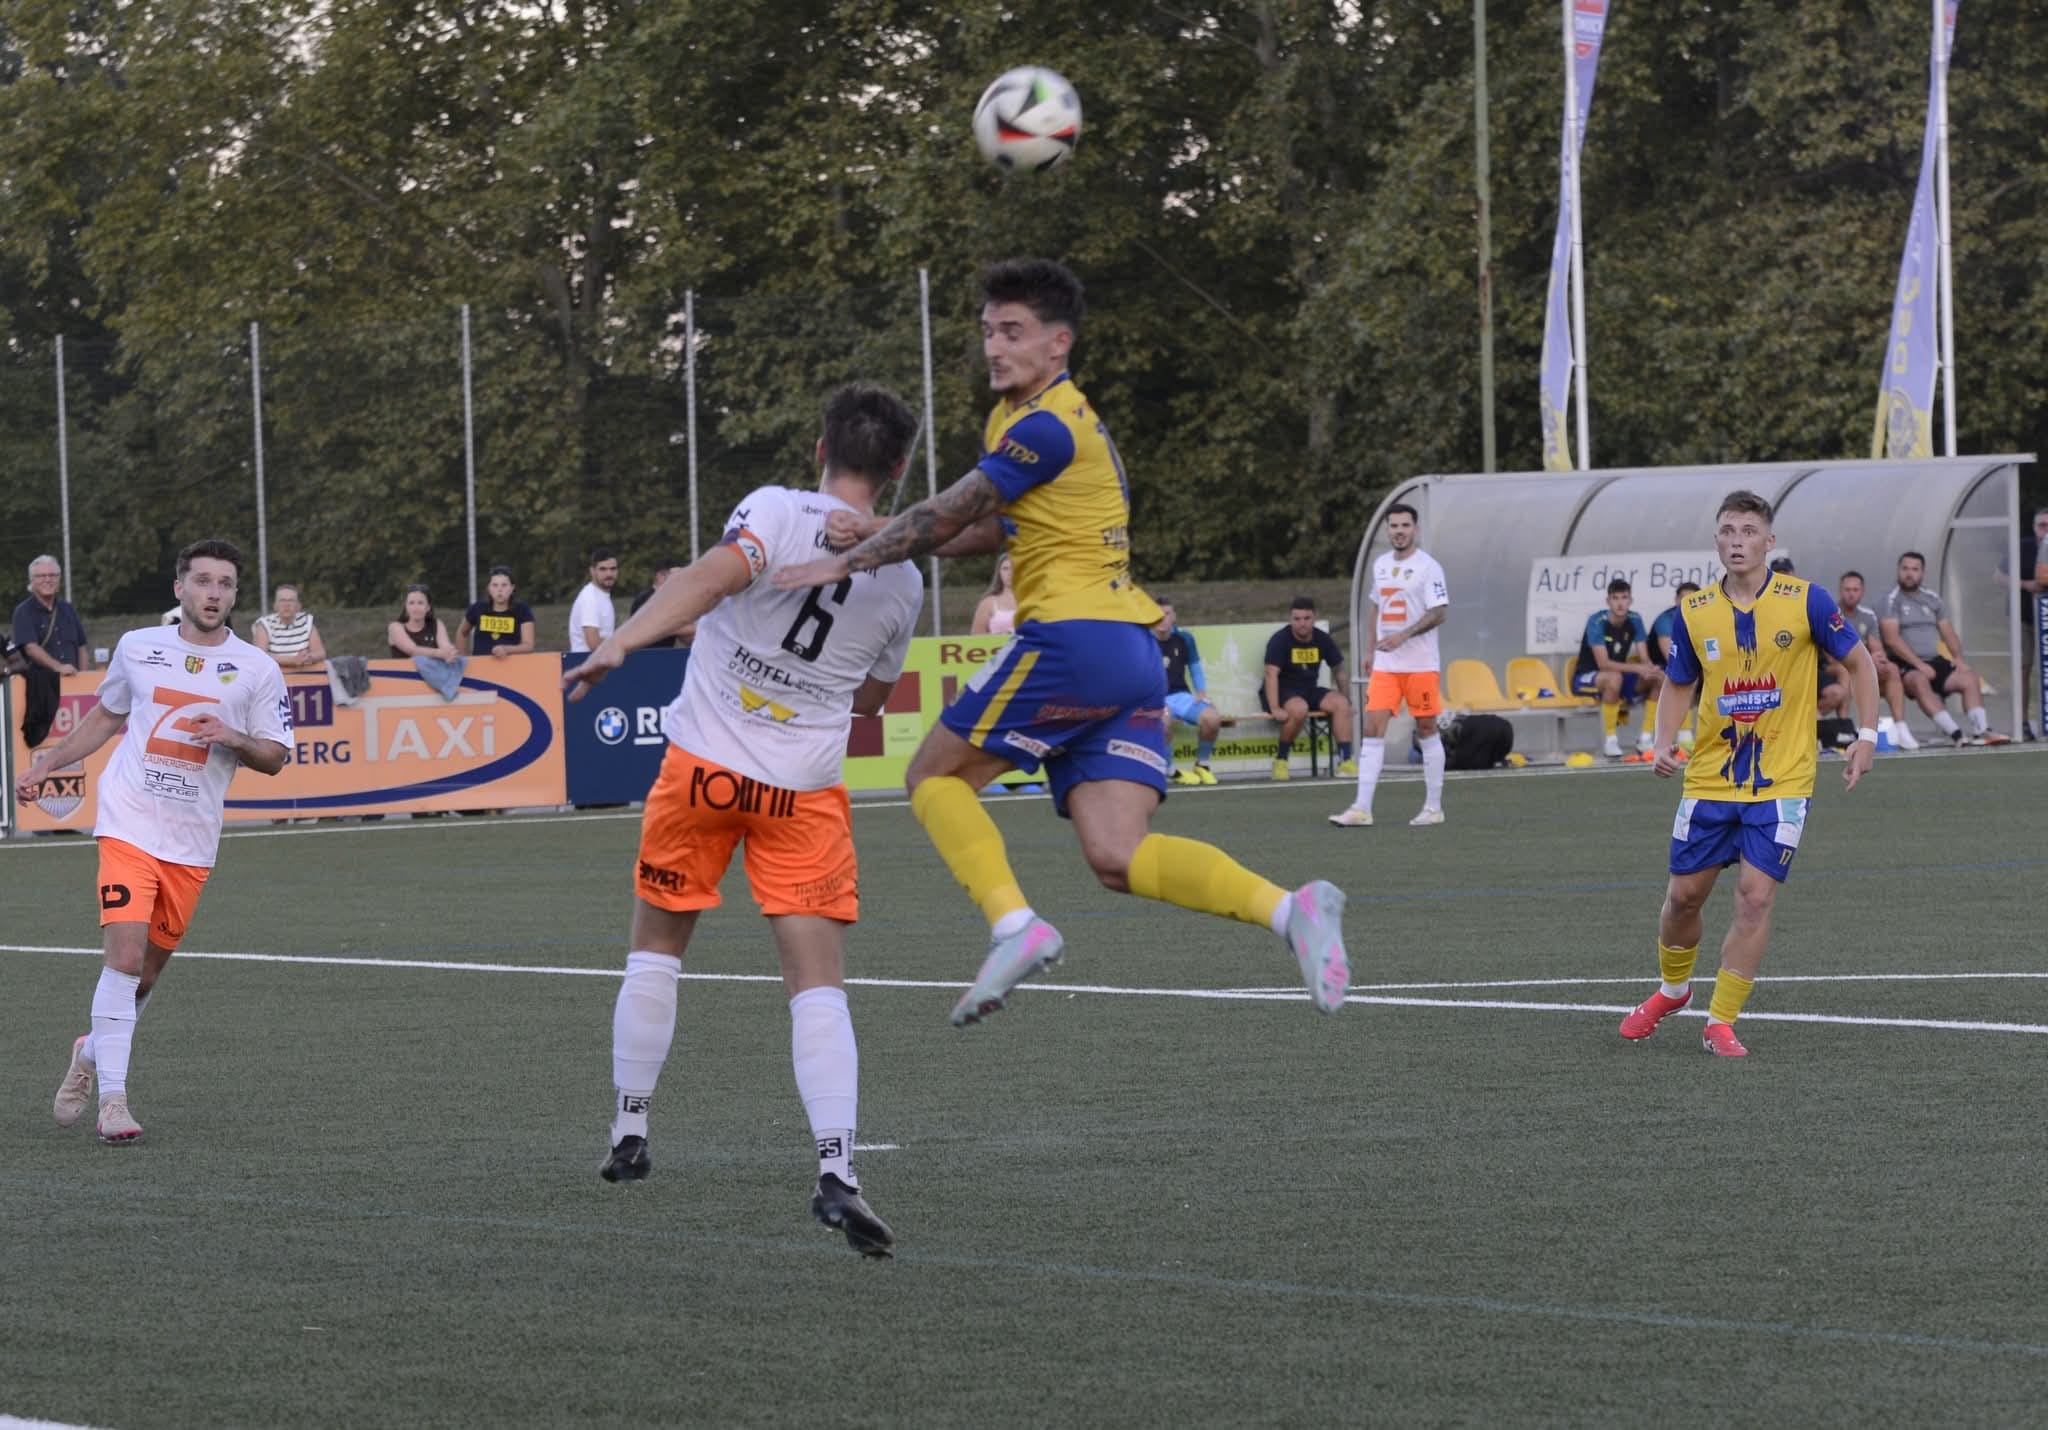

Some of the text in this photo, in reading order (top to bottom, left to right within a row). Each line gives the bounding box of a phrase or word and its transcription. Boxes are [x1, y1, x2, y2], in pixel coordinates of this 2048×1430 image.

[1536, 562, 1722, 592] Auf der Bank
[1774, 581, 1802, 593] HMS
[484, 618, 511, 631] 1935
[781, 575, 853, 663] 6
[734, 646, 792, 687] HOTEL
[284, 741, 351, 764] ERG
[144, 769, 199, 788] RFL
